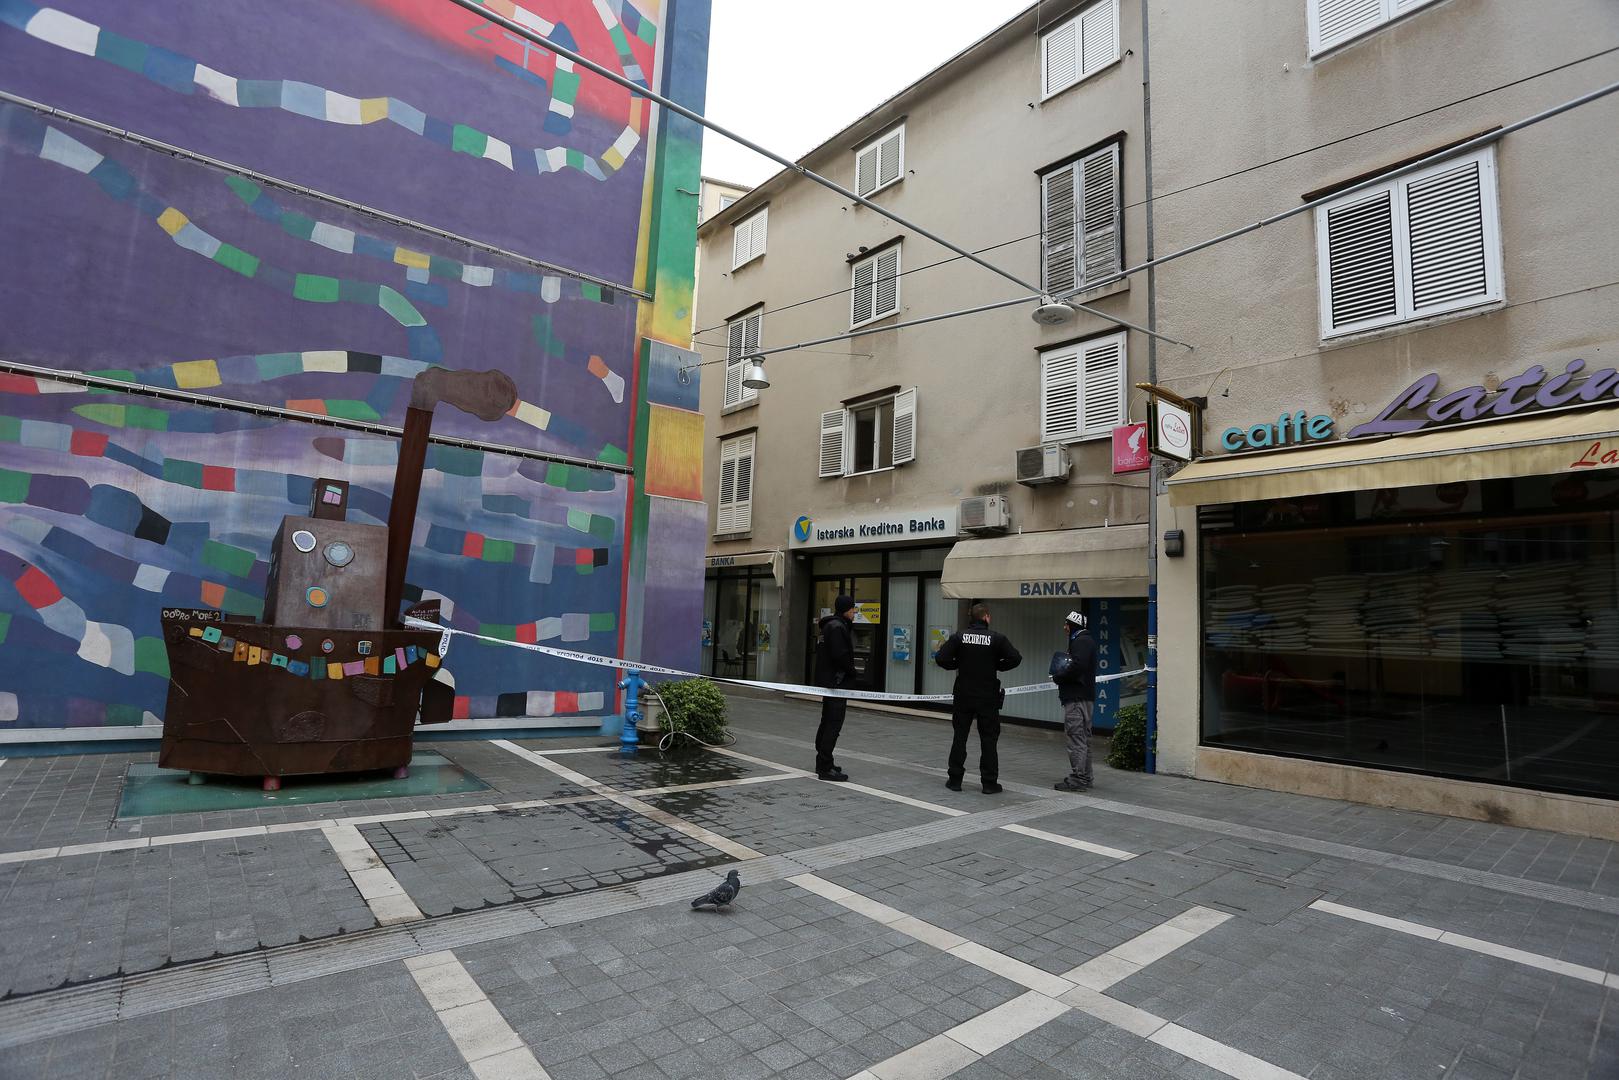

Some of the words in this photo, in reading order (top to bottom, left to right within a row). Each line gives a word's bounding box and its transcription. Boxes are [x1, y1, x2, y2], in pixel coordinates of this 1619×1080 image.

[1221, 410, 1335, 451] caffe
[817, 526, 855, 541] Istarska
[859, 521, 904, 537] Kreditna
[909, 517, 945, 533] Banka
[711, 557, 735, 566] BANKA
[1020, 581, 1081, 595] BANKA
[961, 633, 992, 646] SECURITAS
